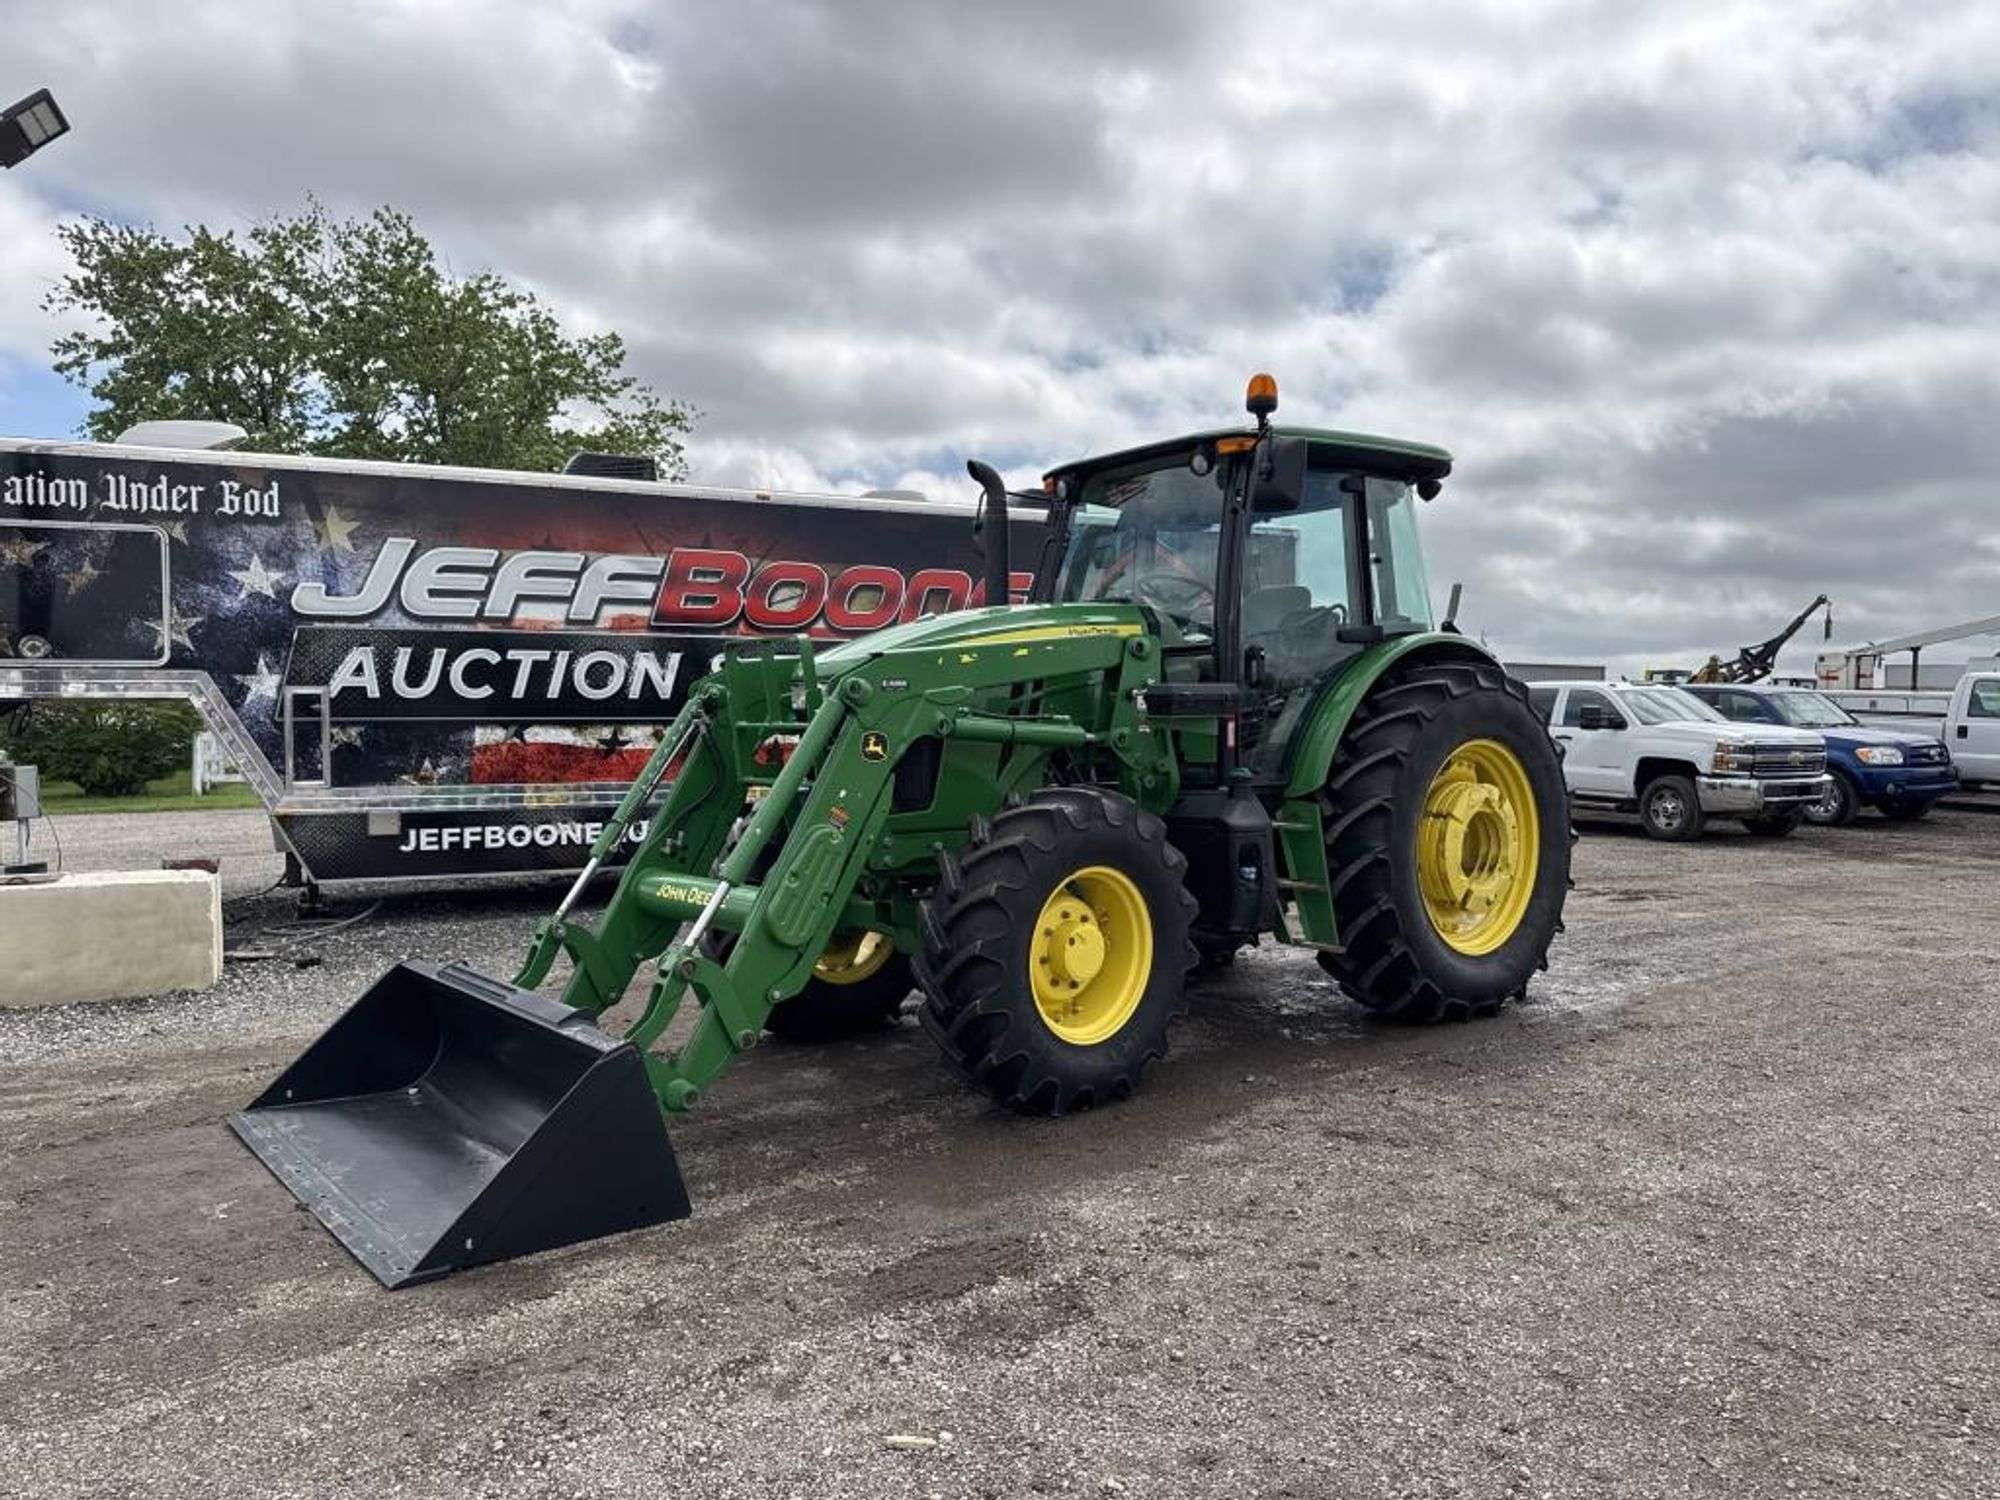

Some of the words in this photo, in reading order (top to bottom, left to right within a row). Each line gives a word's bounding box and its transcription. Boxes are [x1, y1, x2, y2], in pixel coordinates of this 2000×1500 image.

[100, 474, 206, 513] Under
[329, 645, 682, 700] AUCTION
[656, 884, 687, 902] JOHN
